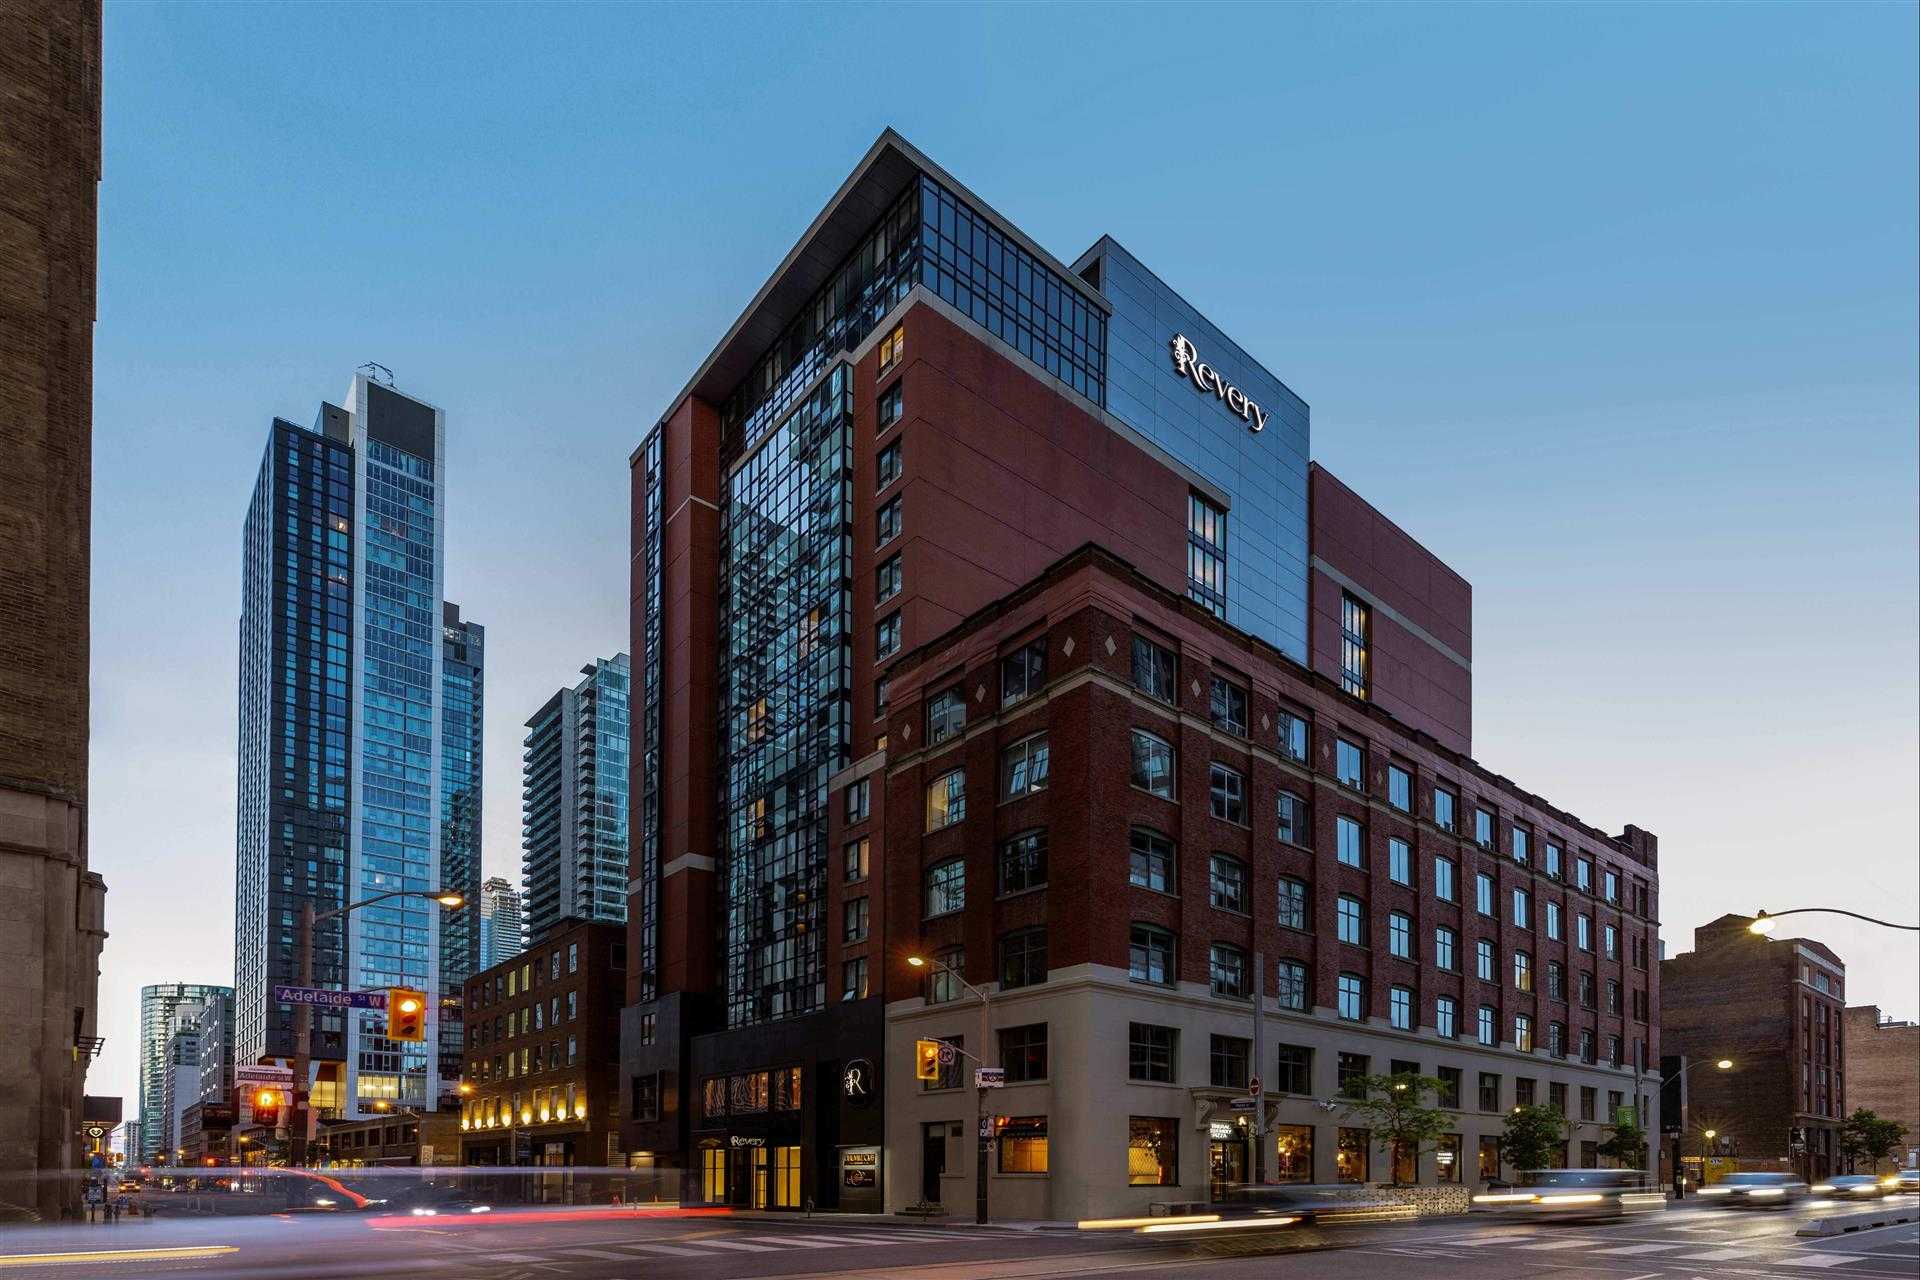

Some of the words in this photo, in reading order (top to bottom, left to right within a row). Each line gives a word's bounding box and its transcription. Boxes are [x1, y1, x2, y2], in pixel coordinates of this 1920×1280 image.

[1171, 332, 1269, 433] Revery
[281, 988, 352, 1005] Adelaide
[369, 995, 381, 1007] W
[239, 1071, 276, 1081] Adelaide
[844, 1068, 867, 1096] R
[730, 1135, 766, 1147] Revery
